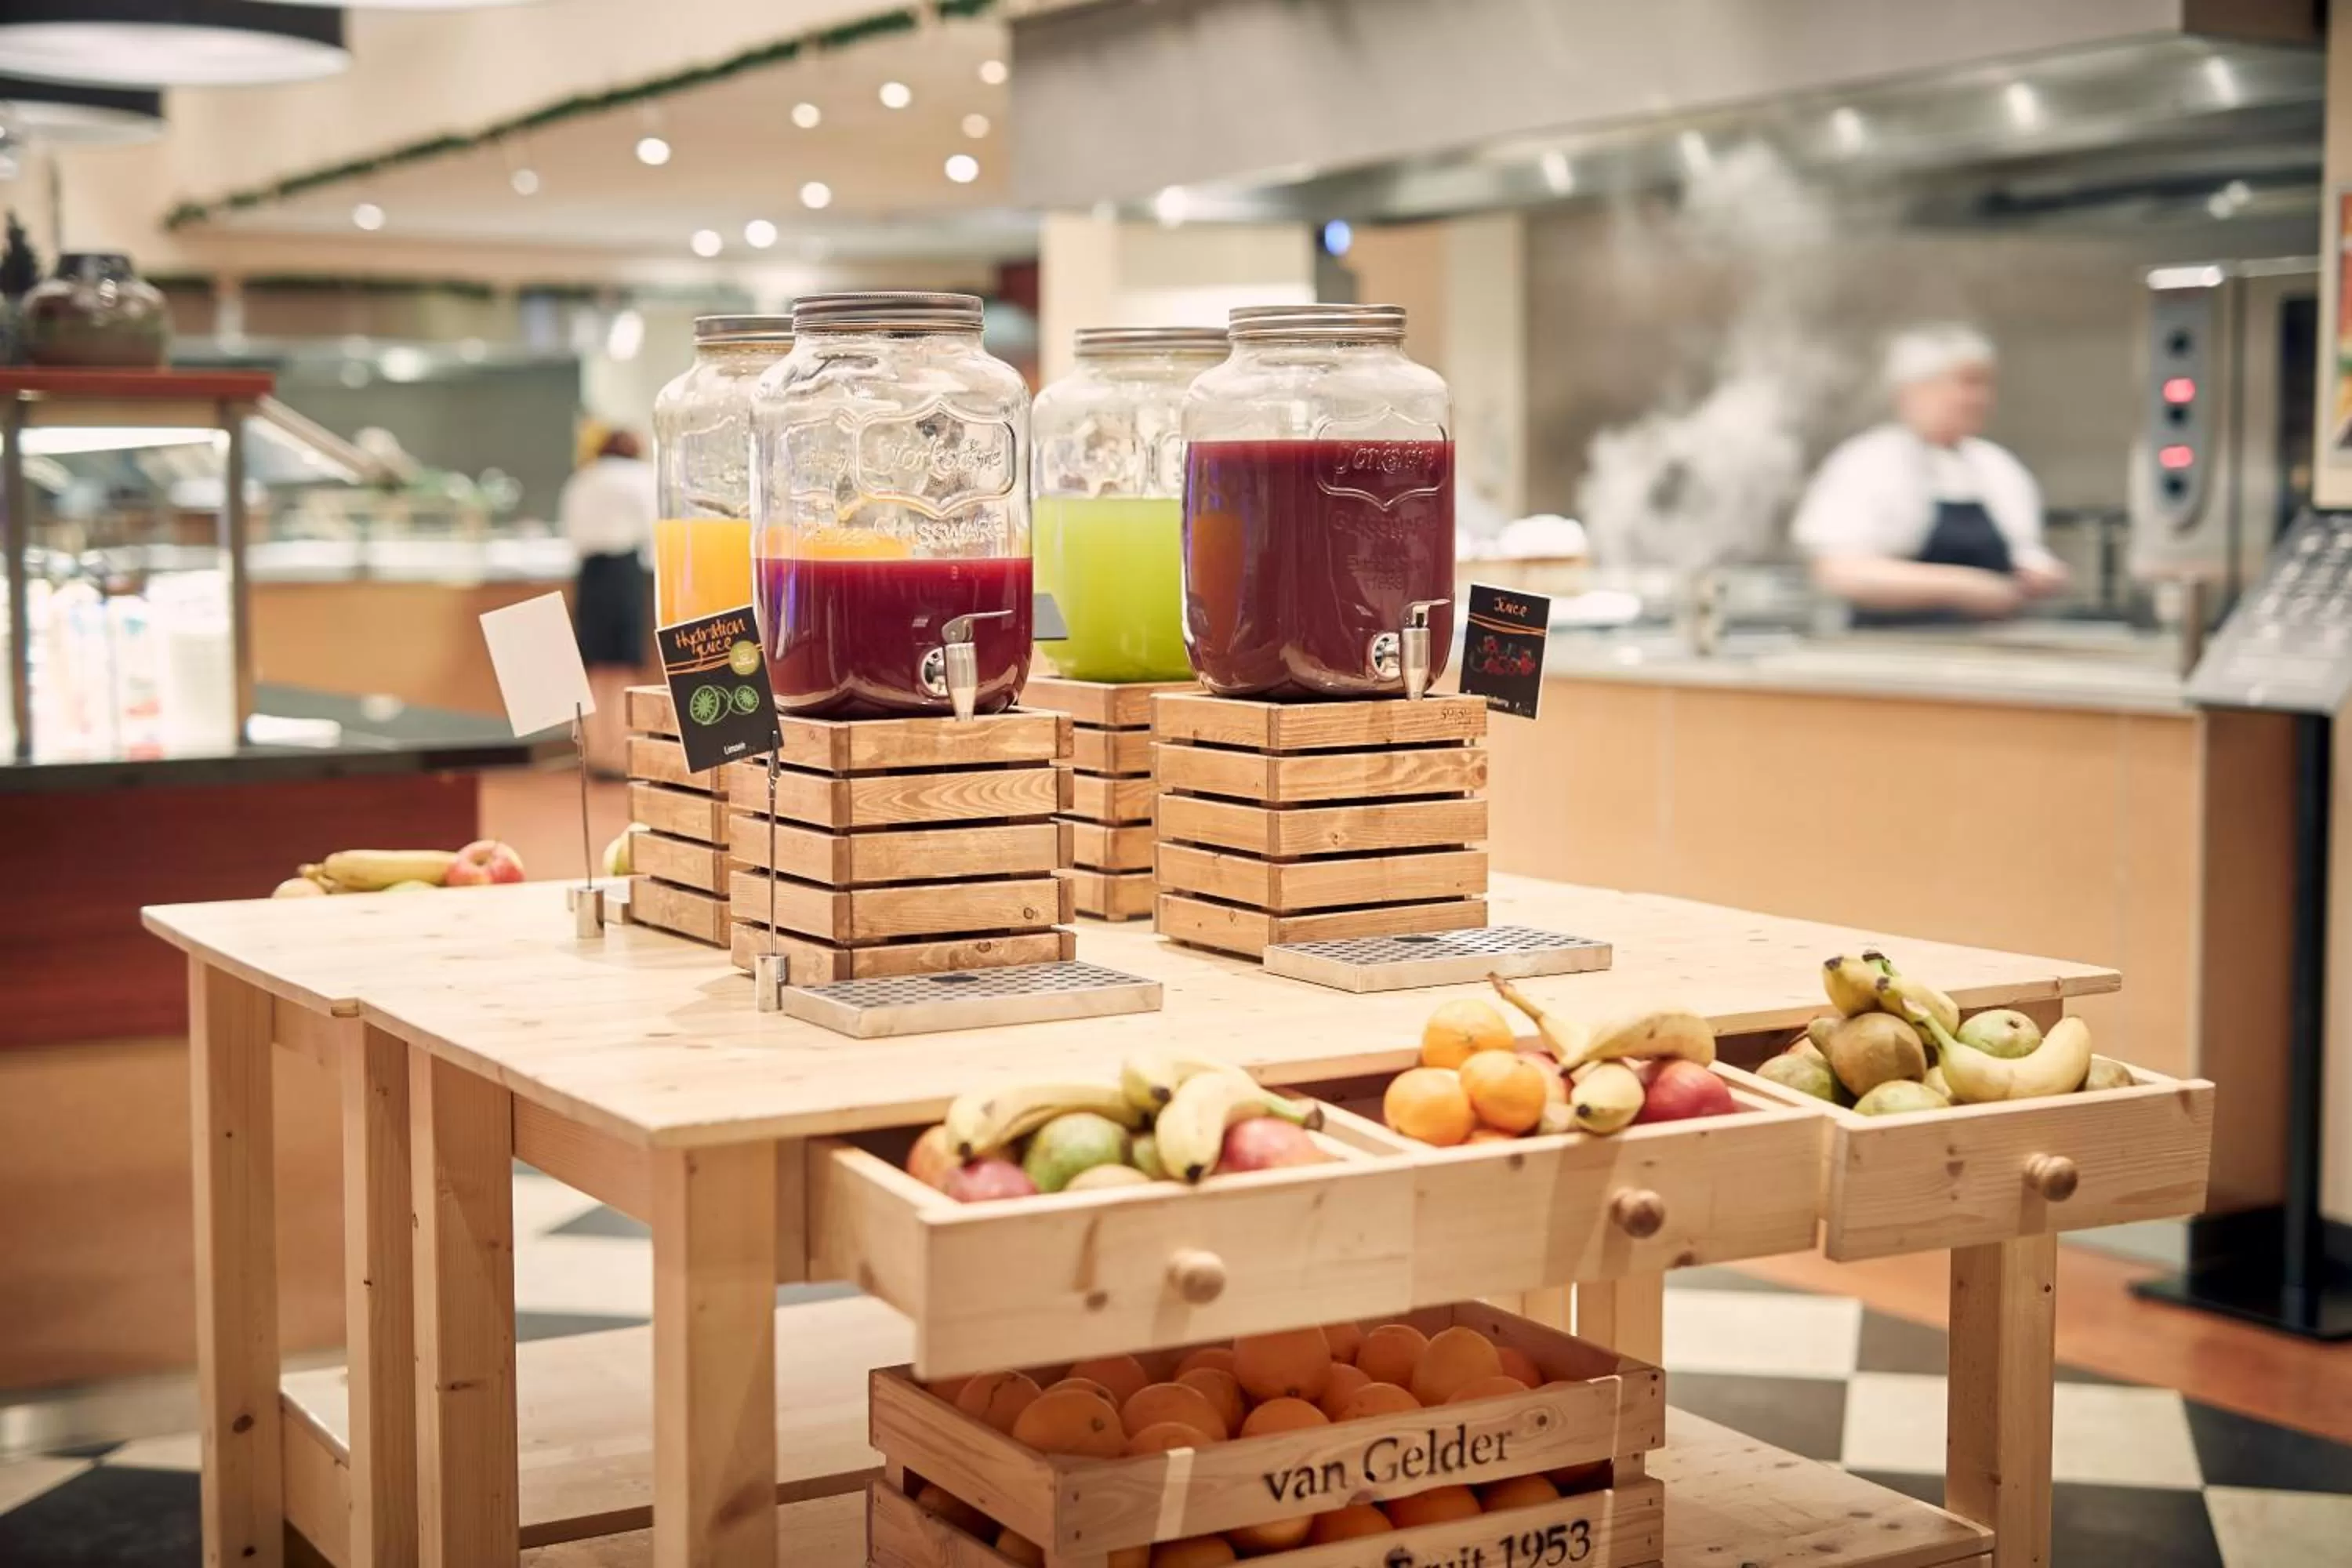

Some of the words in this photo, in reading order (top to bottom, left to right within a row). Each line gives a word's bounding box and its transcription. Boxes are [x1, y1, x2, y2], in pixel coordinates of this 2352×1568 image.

[1363, 1424, 1513, 1483] Gelder
[1262, 1460, 1347, 1503] van
[1498, 1519, 1591, 1568] 1953
